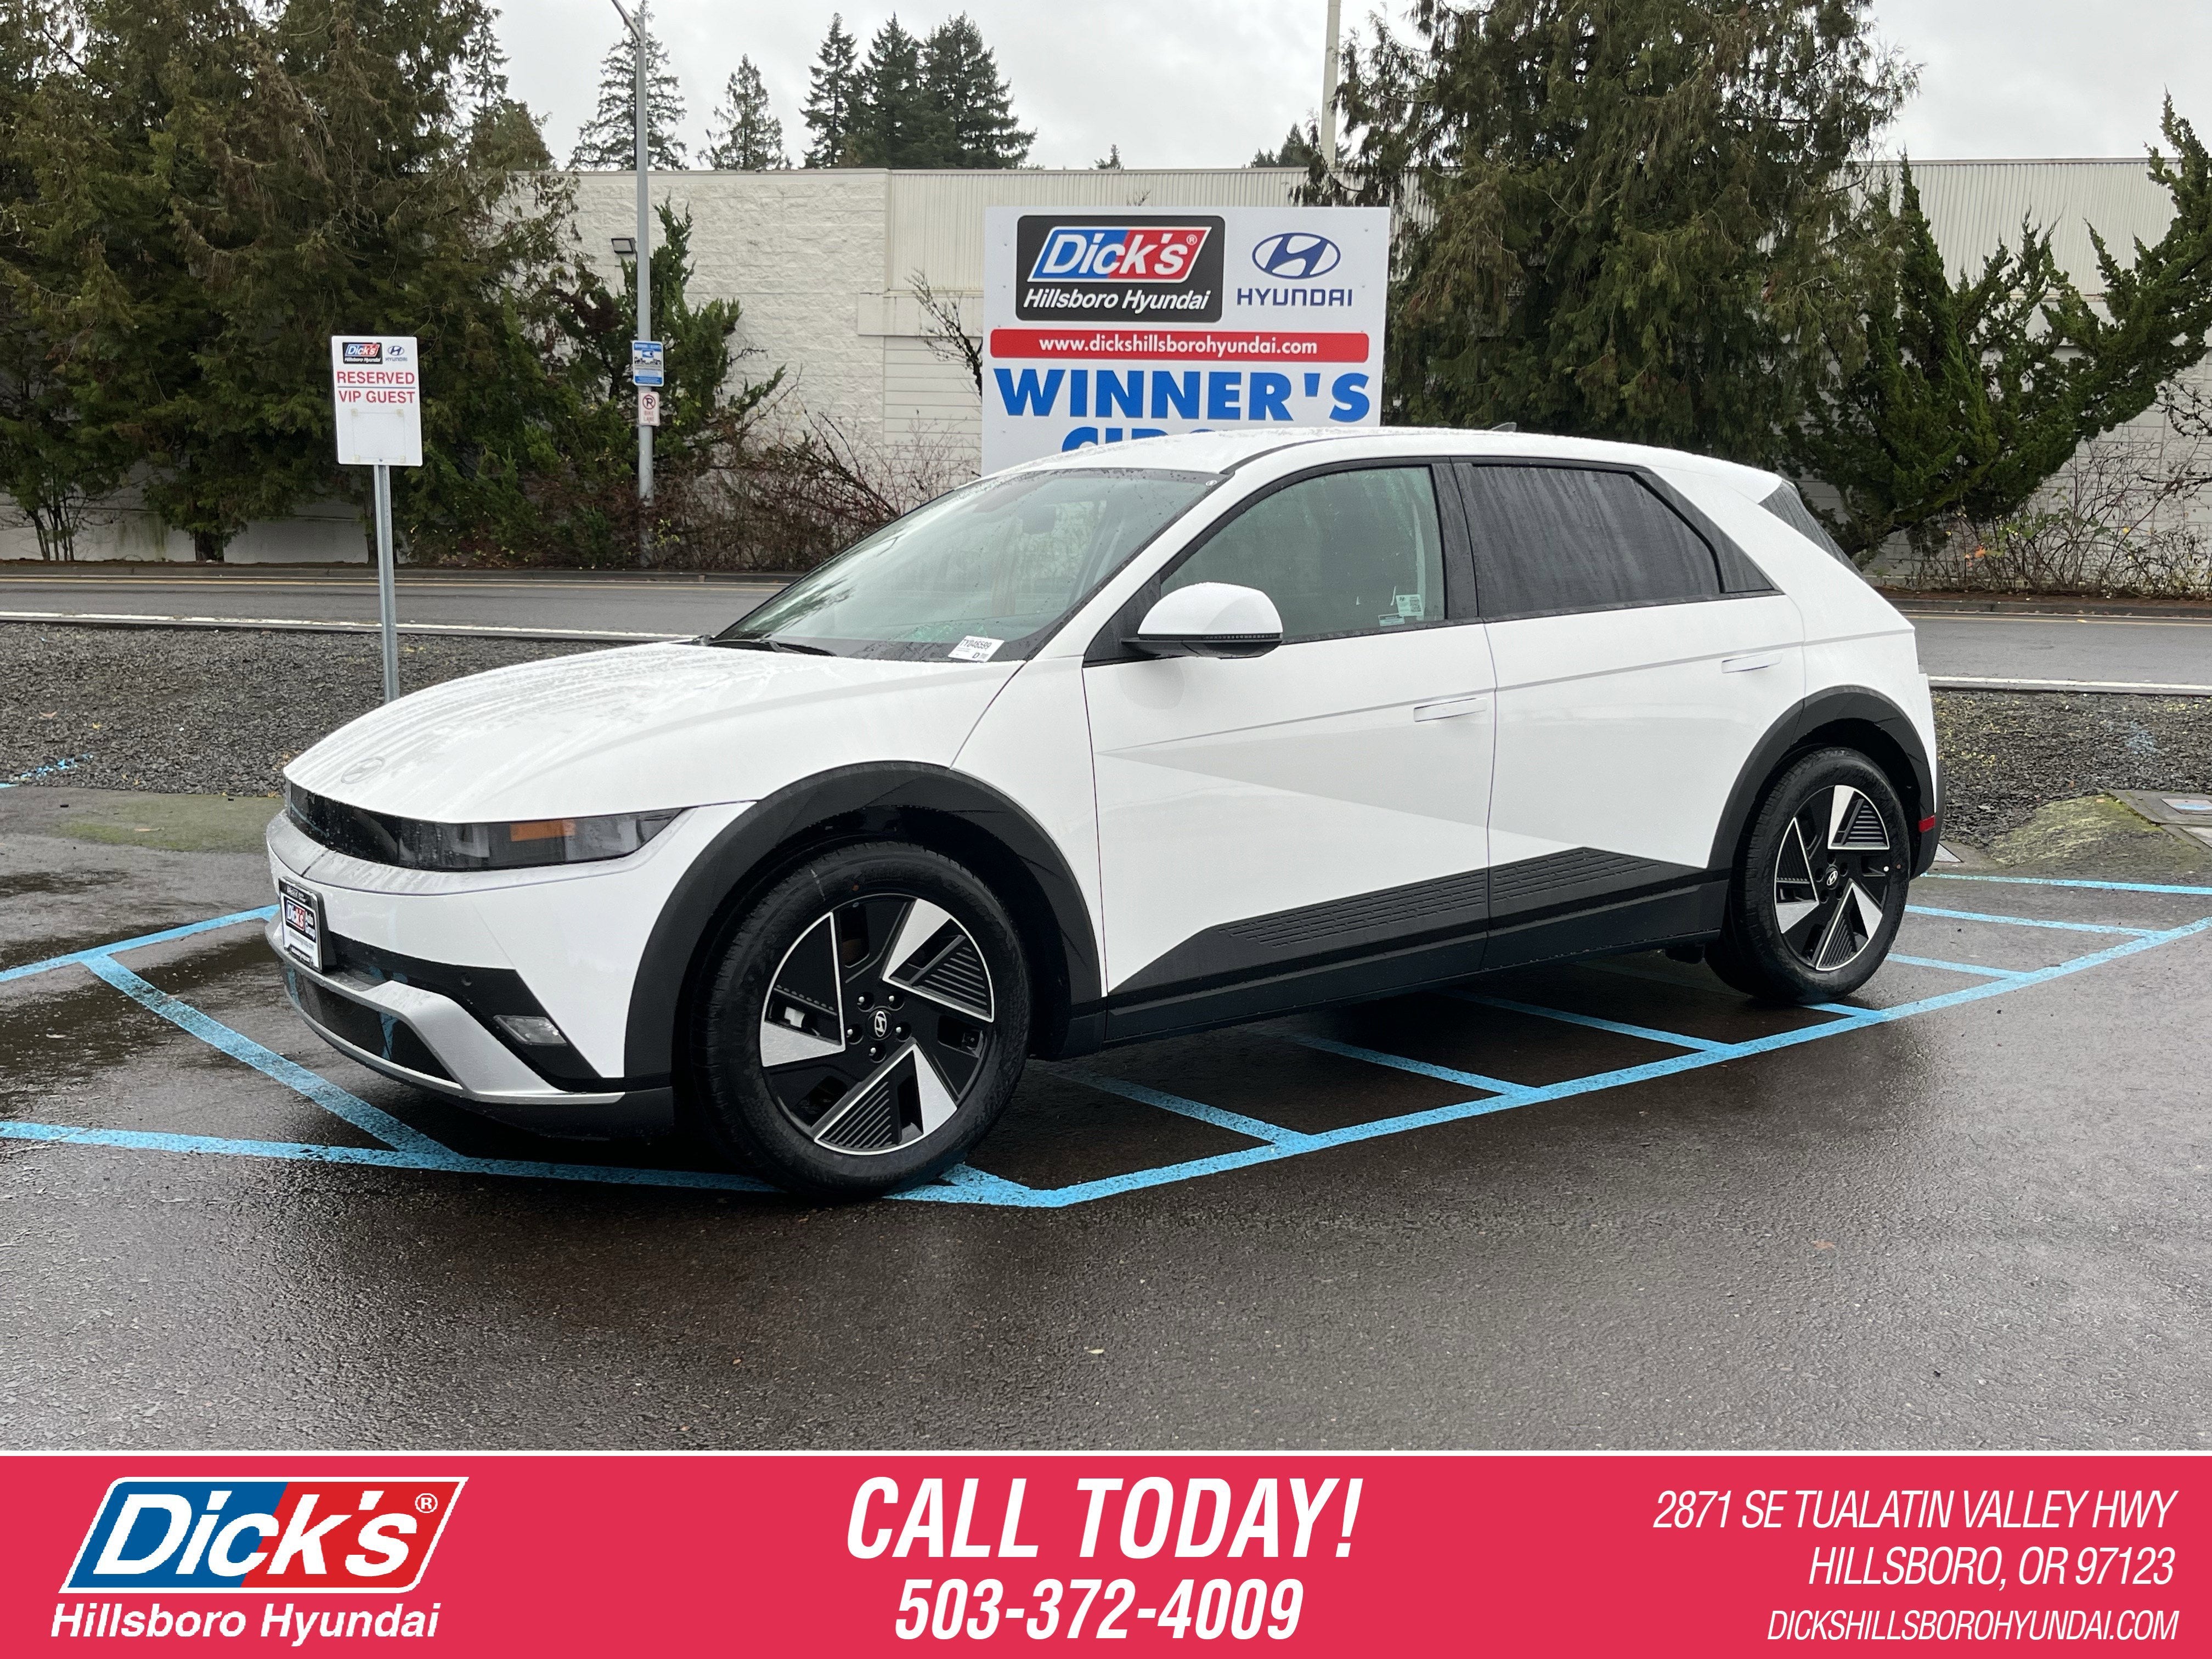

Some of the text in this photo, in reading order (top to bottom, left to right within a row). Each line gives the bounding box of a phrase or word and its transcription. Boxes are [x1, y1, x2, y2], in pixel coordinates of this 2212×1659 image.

[1042, 233, 1188, 275] Dick's
[1023, 288, 1212, 314] Hillsboro Hyundai
[1237, 288, 1353, 307] HYUNDAI
[348, 345, 377, 356] Dick's
[1039, 330, 1317, 358] www.dickshillsborohyundai.com
[337, 371, 415, 385] RESERVED
[338, 390, 416, 404] VIP GUEST
[993, 368, 1370, 422] WINNER'S
